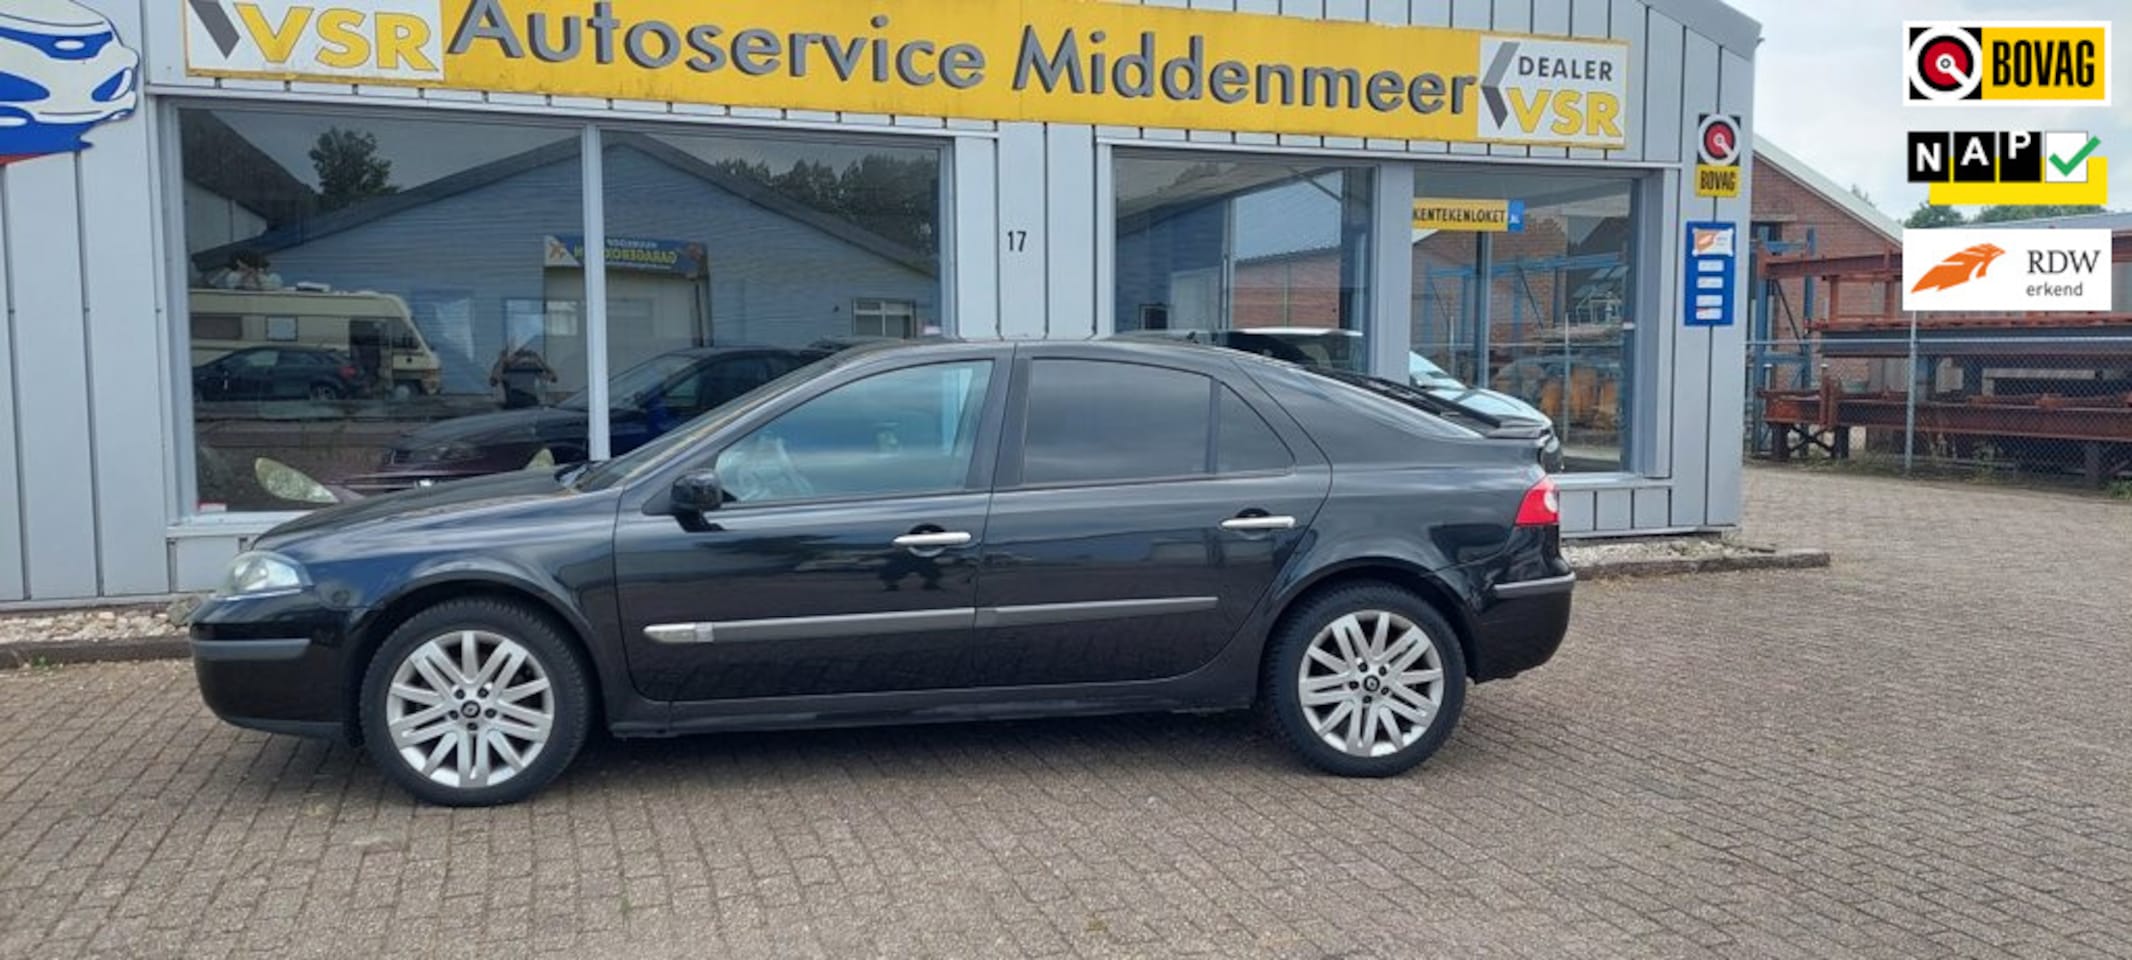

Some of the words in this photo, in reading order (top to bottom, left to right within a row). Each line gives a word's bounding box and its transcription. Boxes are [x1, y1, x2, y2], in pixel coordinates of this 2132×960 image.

[235, 3, 438, 72] VSR
[447, 0, 985, 89] Autoservice
[1013, 24, 1476, 114] Middenmeer
[1519, 56, 1613, 81] DEALER
[1505, 88, 1622, 138] VSR
[1701, 170, 1737, 191] BOVAG
[1413, 208, 1505, 223] KENTEKENLOKET
[1007, 230, 1027, 252] 17
